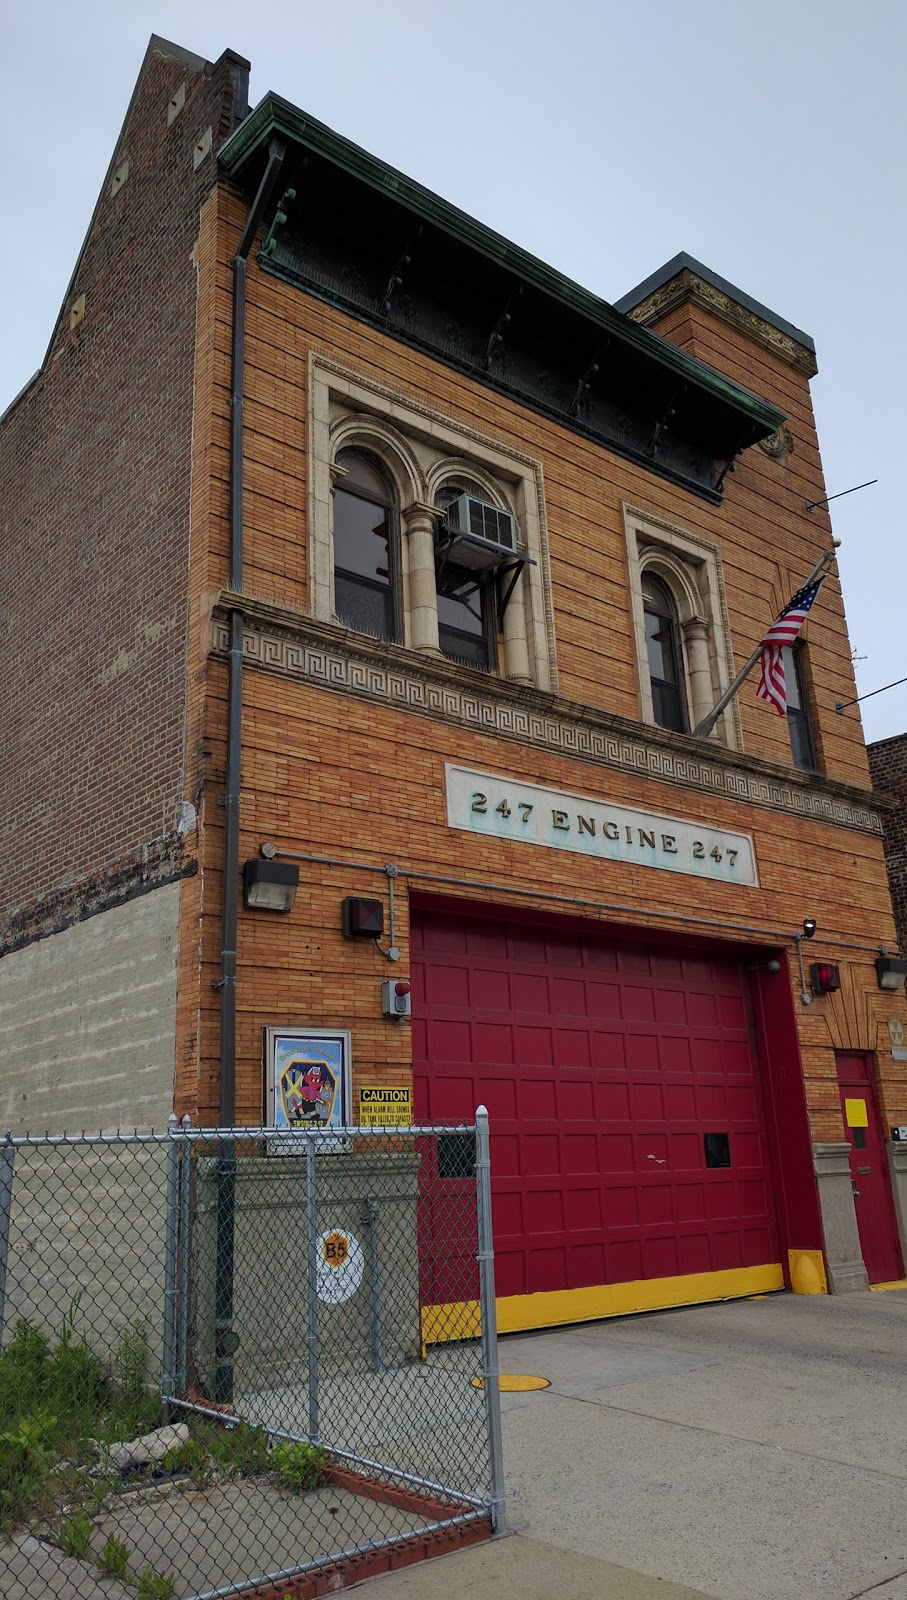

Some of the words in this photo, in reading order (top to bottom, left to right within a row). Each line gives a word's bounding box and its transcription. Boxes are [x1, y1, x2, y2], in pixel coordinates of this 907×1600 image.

[471, 792, 534, 823] 247
[552, 809, 678, 854] ENGINE
[692, 841, 739, 866] 247
[362, 1090, 408, 1101] CAUTION
